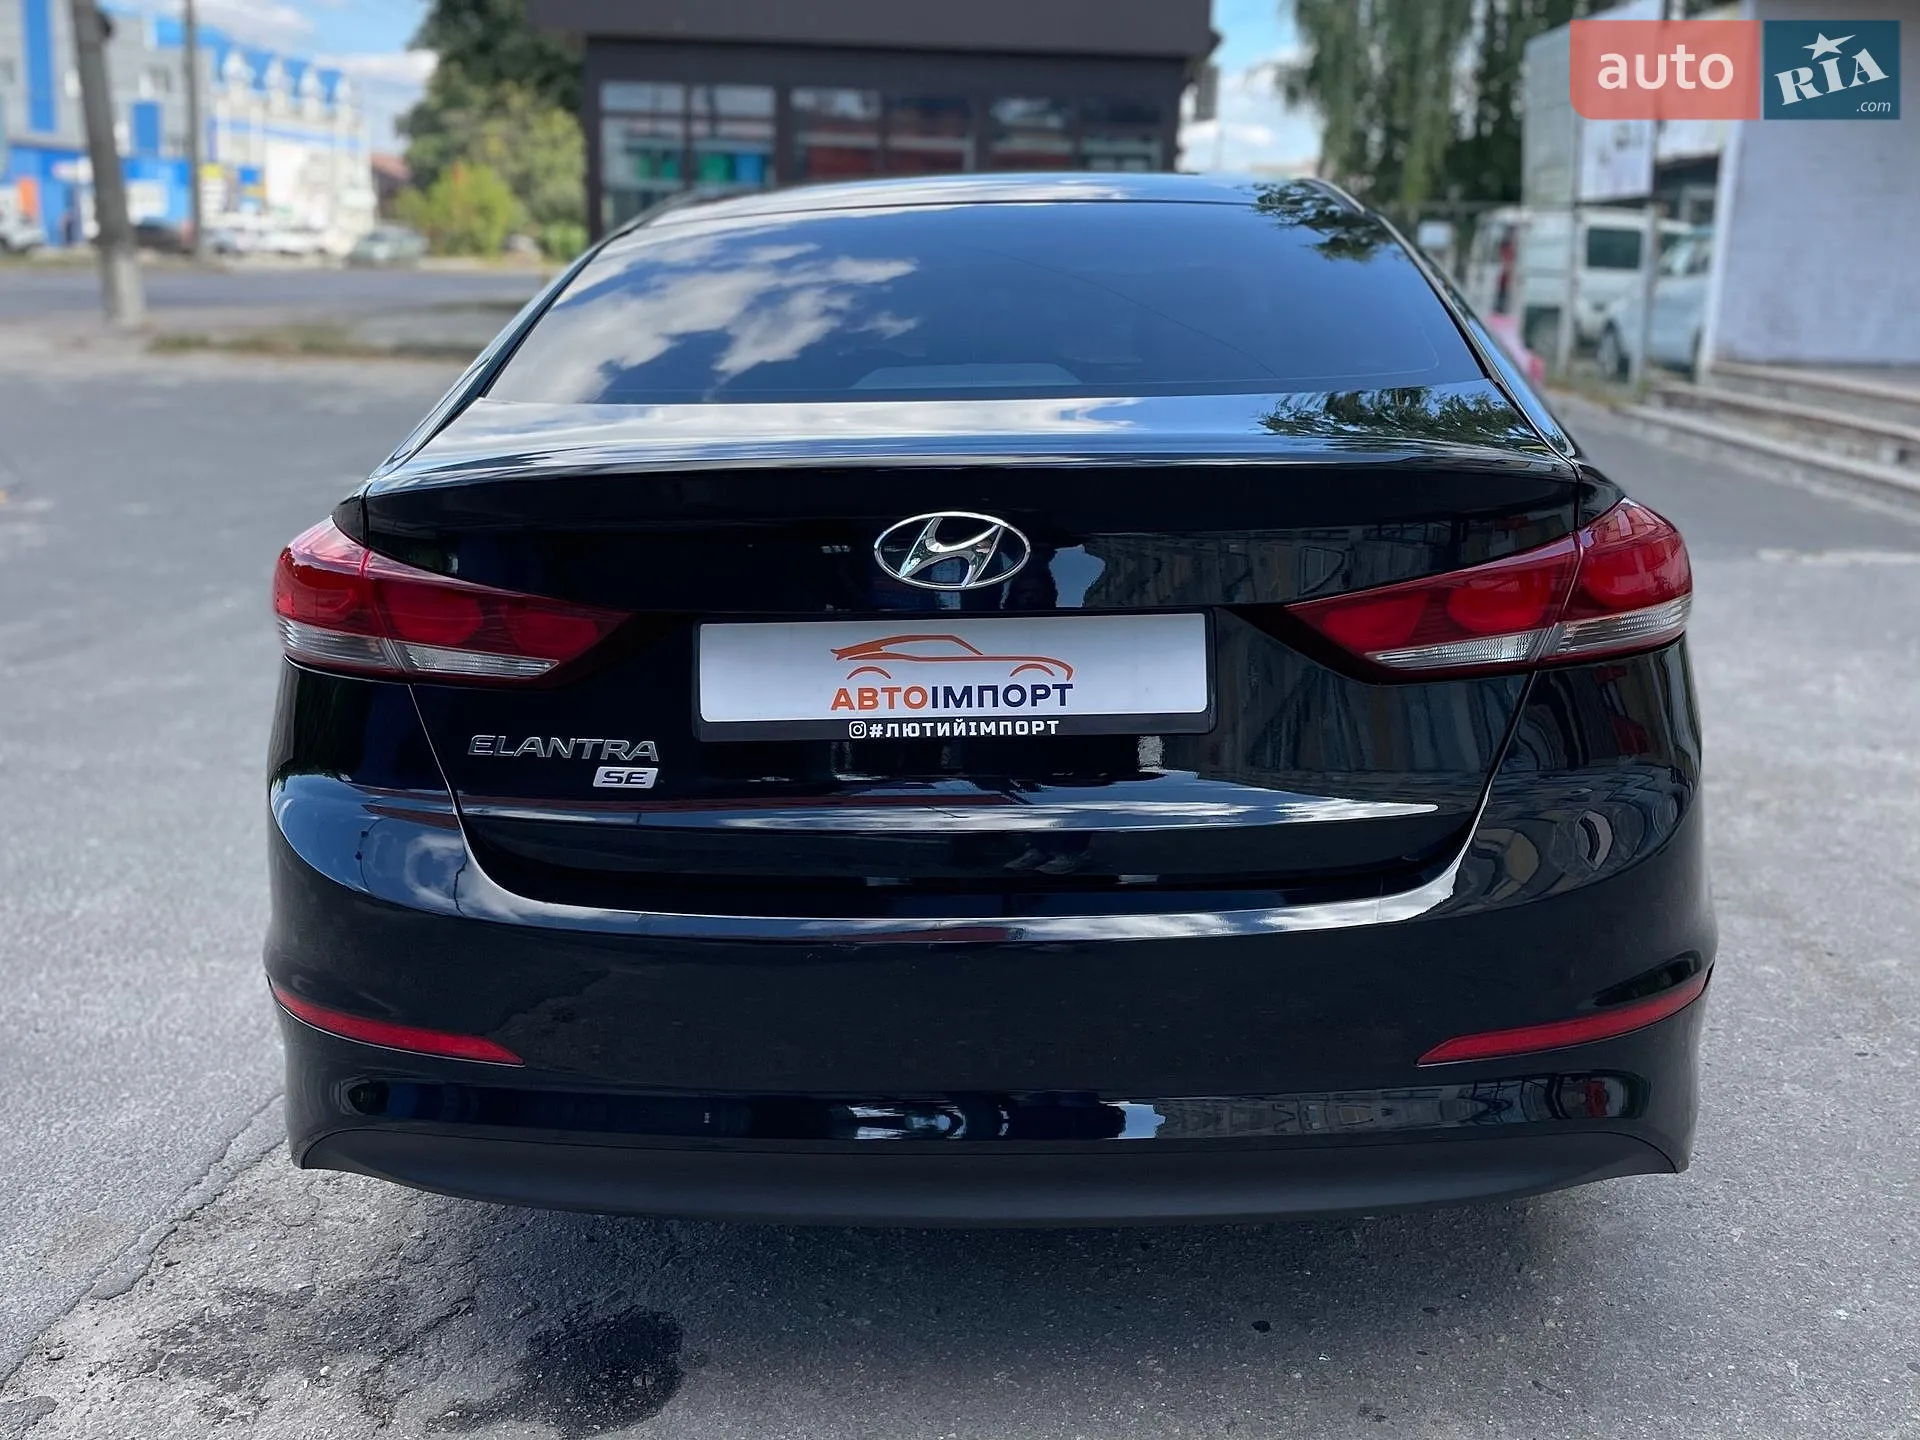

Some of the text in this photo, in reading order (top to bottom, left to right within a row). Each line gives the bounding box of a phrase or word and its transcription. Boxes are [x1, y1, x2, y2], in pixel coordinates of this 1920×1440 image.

[831, 683, 1073, 711] АВТОІМПОРТ
[467, 734, 660, 762] ELANTRA
[602, 770, 648, 785] SE
